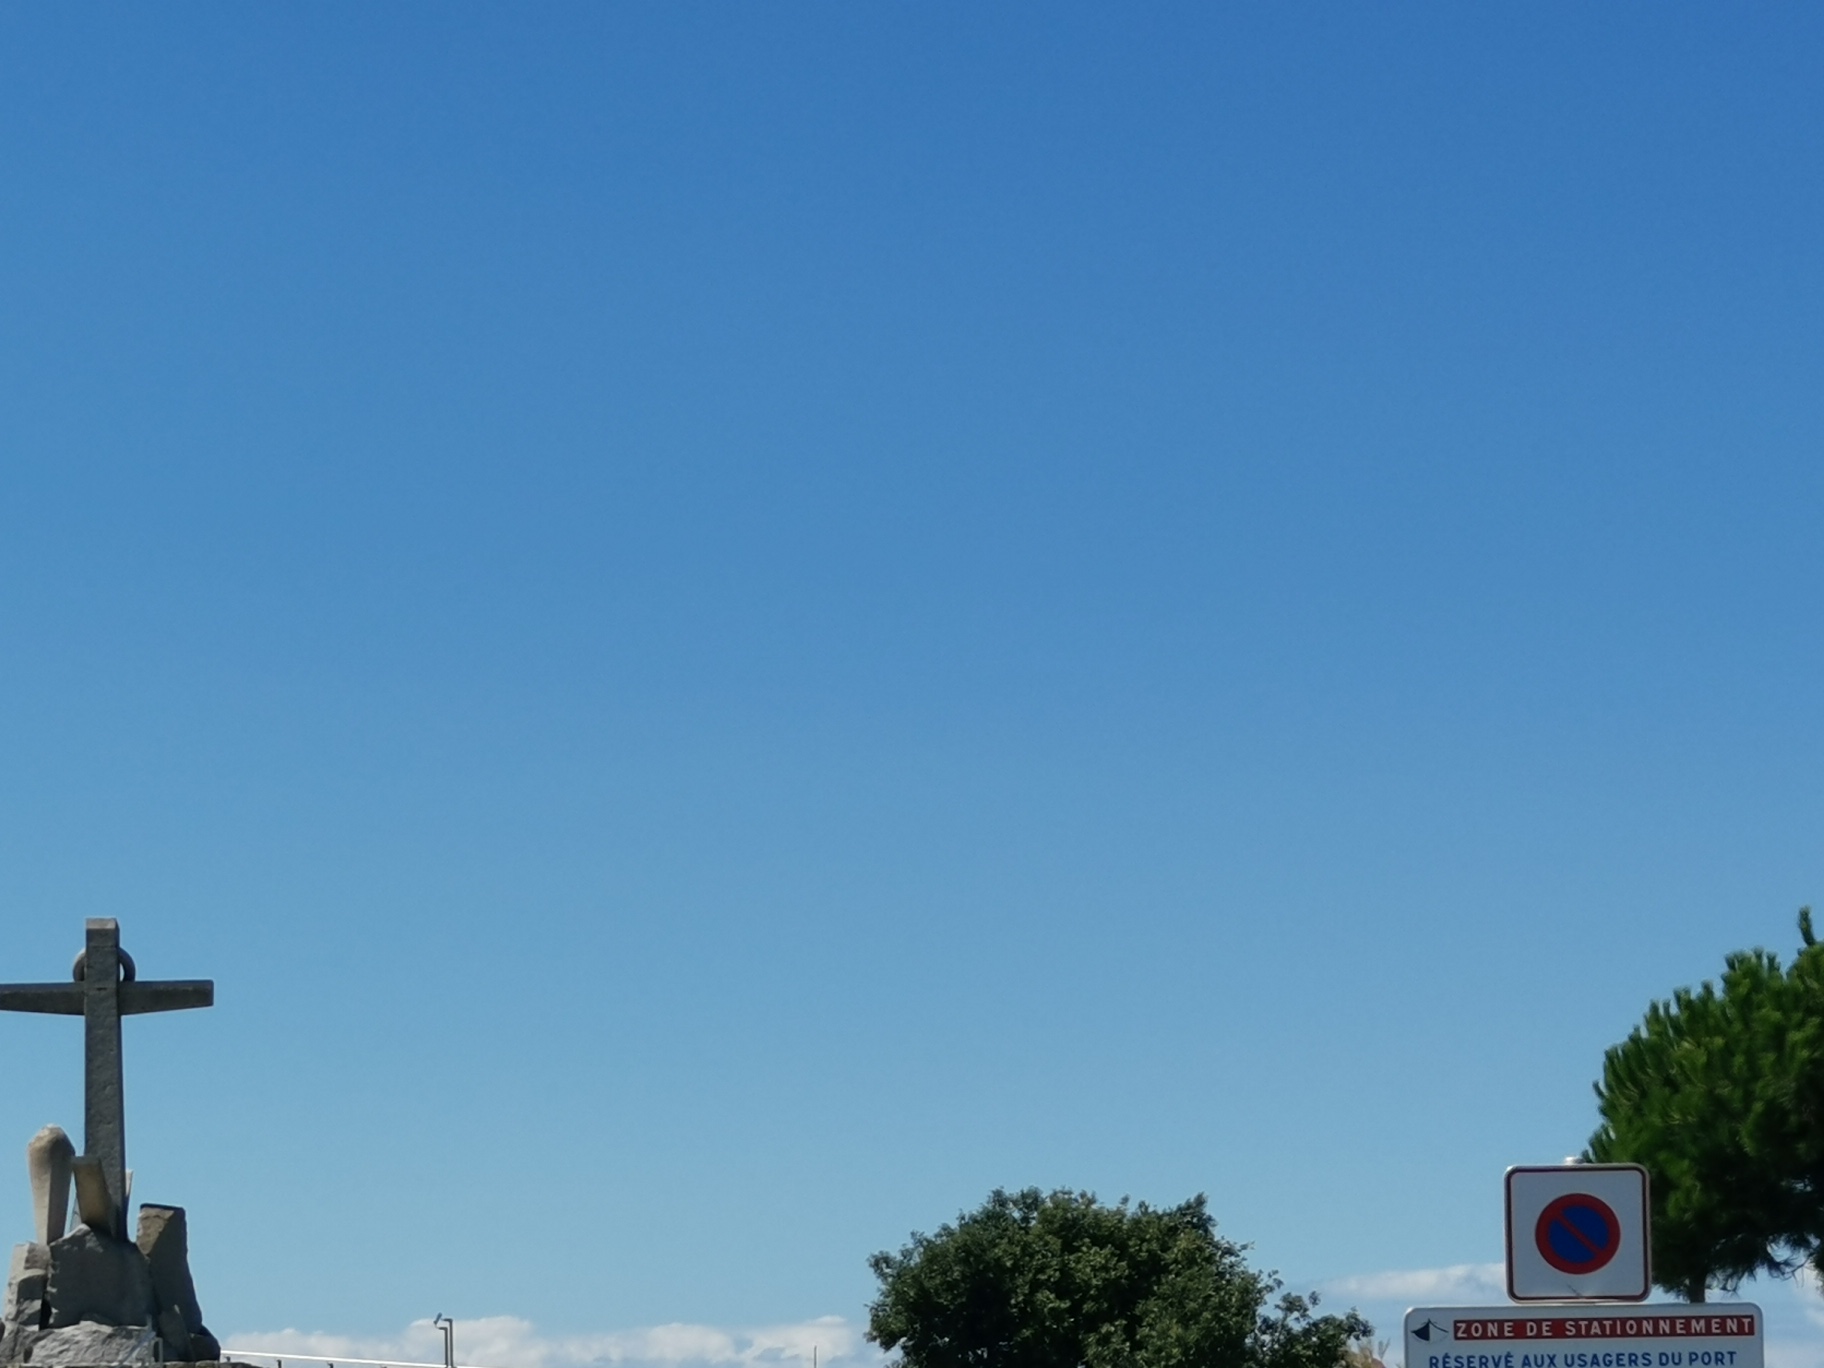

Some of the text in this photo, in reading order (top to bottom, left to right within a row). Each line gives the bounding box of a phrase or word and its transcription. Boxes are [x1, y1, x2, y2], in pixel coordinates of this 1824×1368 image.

[1456, 1317, 1753, 1338] ZONE DE STATIONNEMENT
[1521, 1354, 1558, 1368] AUX
[1564, 1352, 1653, 1368] USAGERS
[1658, 1352, 1682, 1367] DU
[1688, 1351, 1737, 1366] PORT
